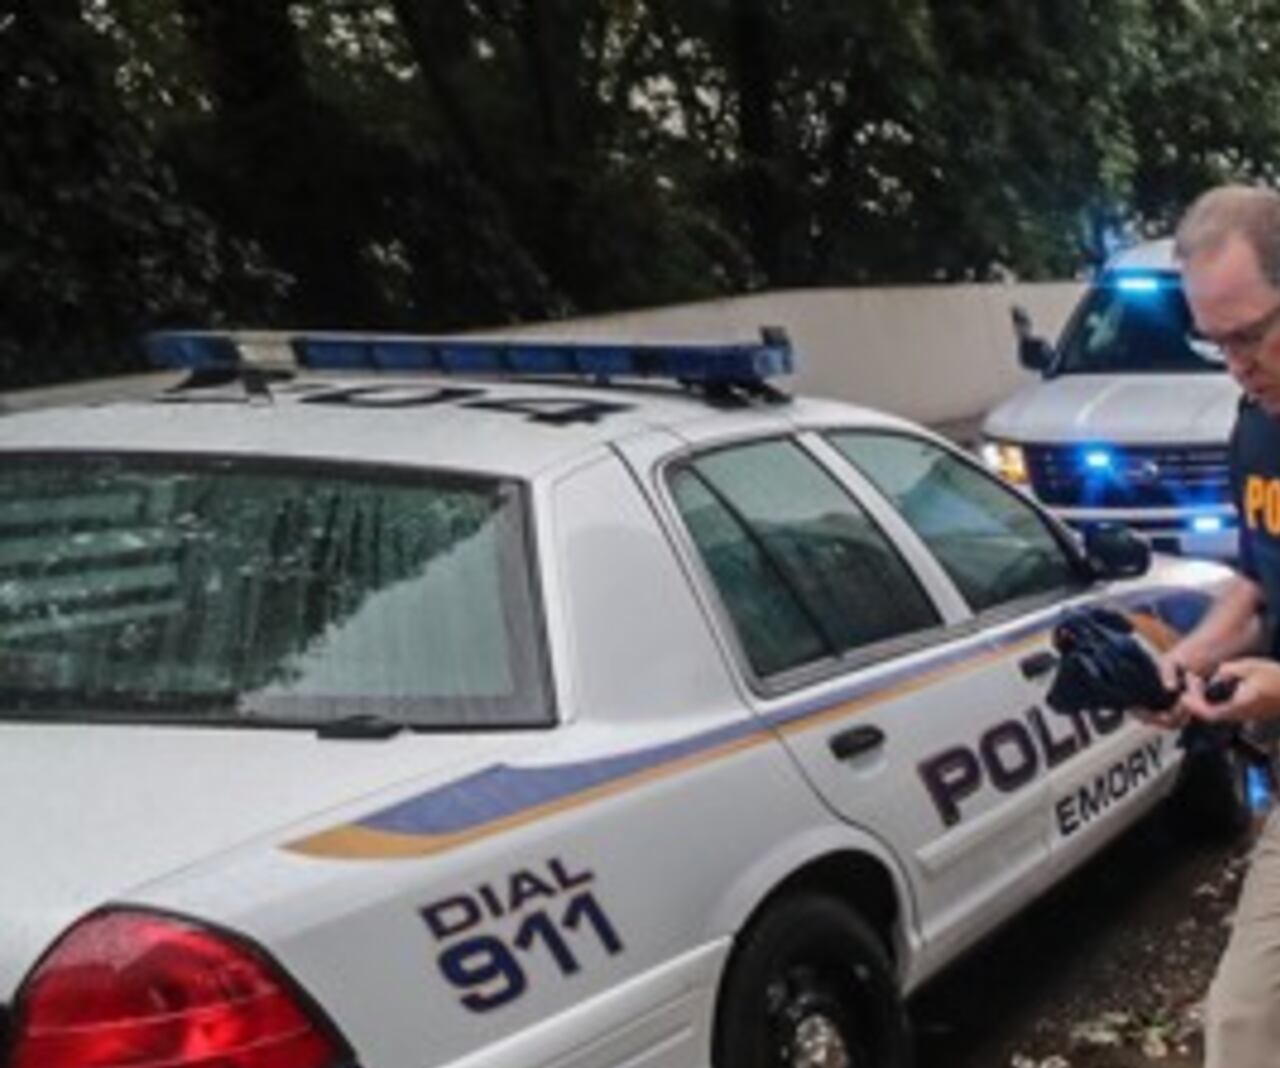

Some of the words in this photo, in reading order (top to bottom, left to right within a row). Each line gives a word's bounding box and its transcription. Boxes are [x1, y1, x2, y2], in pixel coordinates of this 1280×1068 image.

[1055, 736, 1164, 837] EMORY
[419, 856, 595, 942] DIAL
[437, 889, 626, 1015] 911
